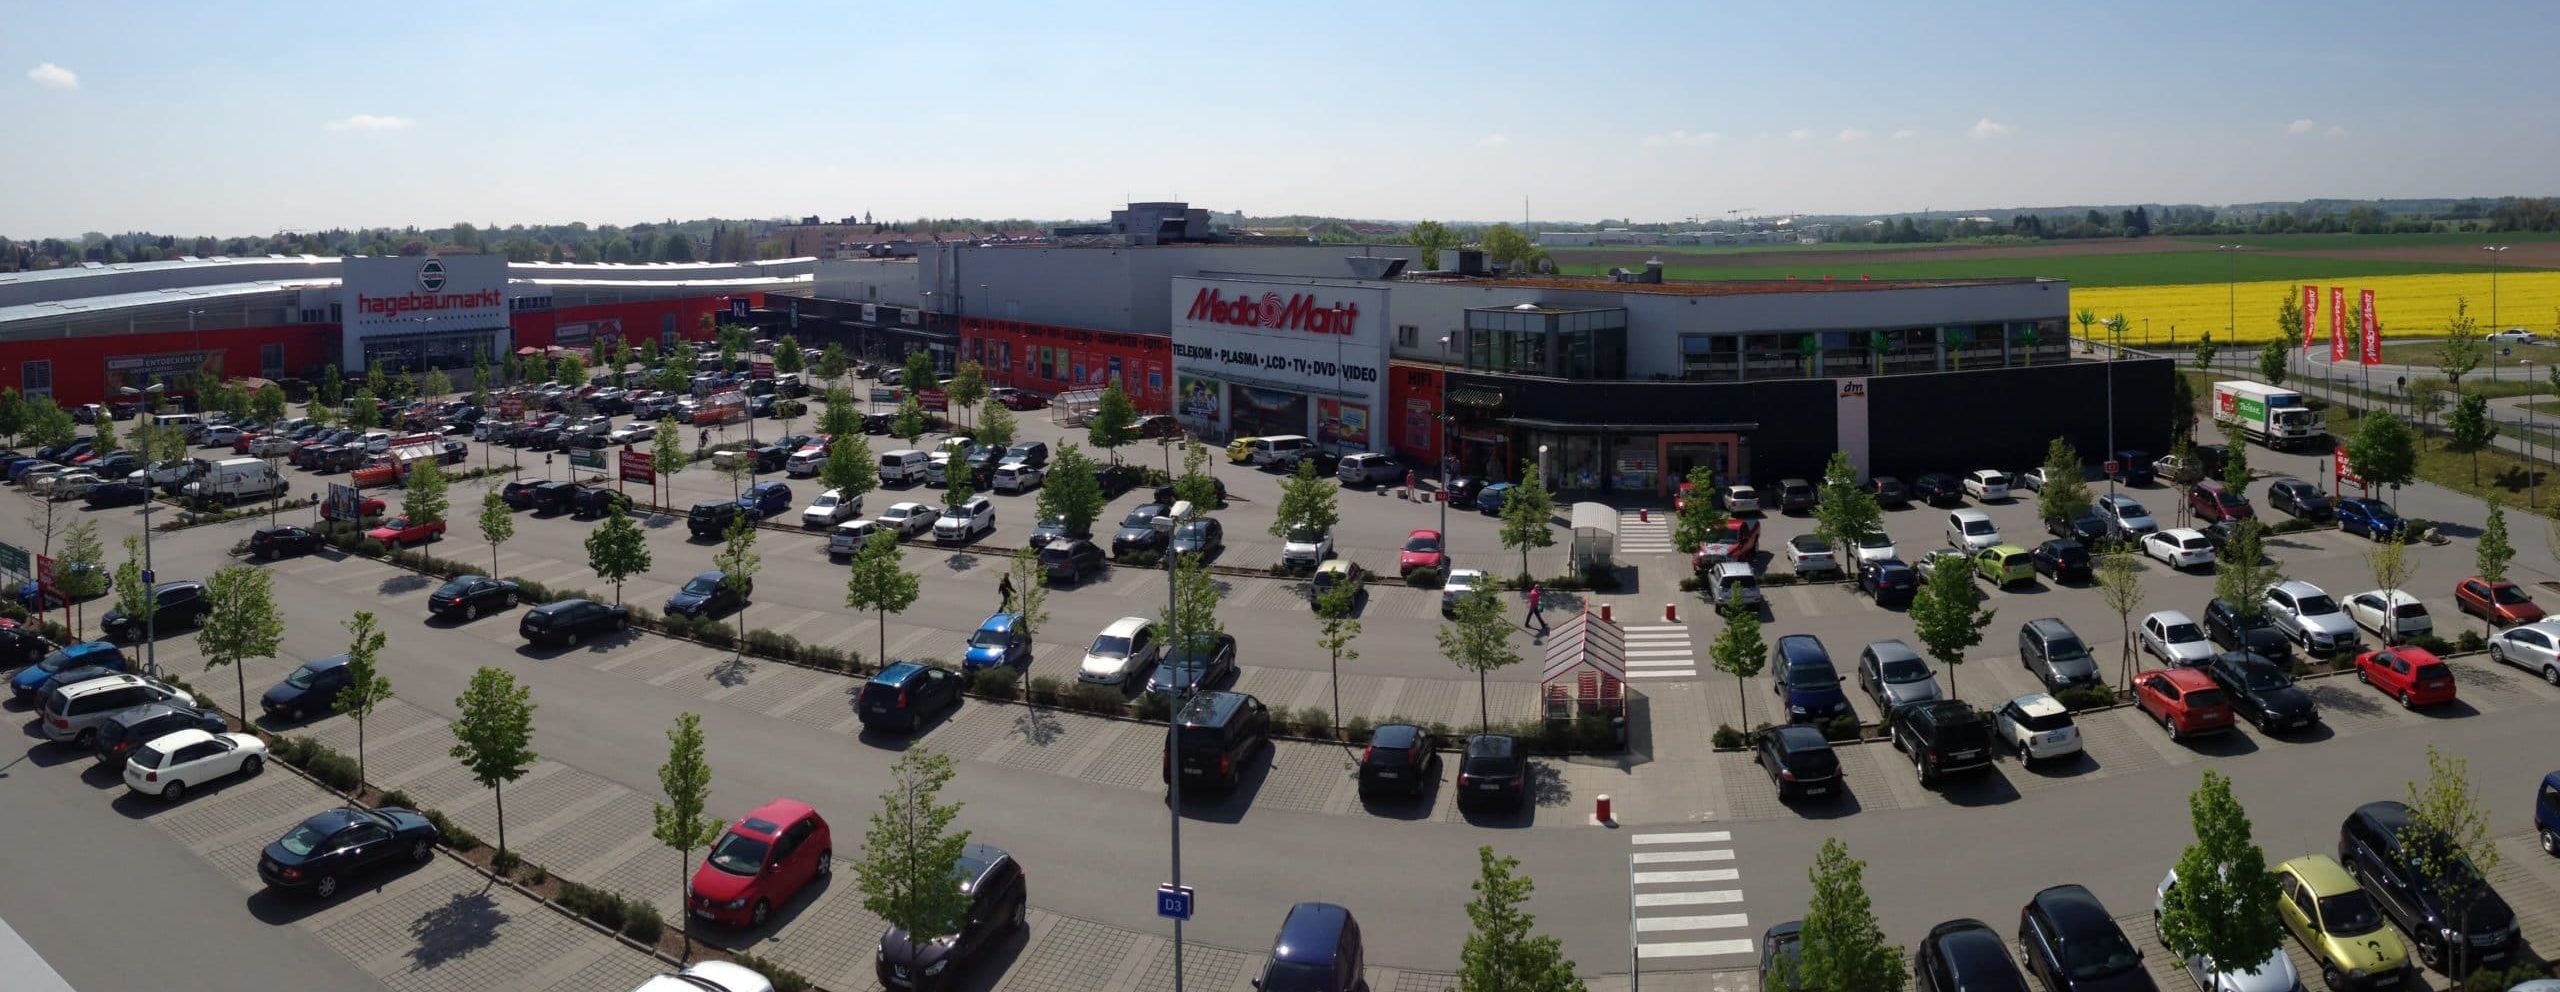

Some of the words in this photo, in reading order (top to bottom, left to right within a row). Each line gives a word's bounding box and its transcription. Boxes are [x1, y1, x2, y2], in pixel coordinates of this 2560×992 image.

[359, 288, 500, 317] hagebaumarkt
[1172, 343, 1212, 360] TELEKOM
[1220, 350, 1258, 367] PLASMA
[1266, 355, 1286, 370] LCD
[1293, 358, 1306, 373] TV
[1313, 363, 1336, 377] DVD
[1342, 365, 1377, 382] VIDEO
[1408, 371, 1432, 388] HIFI
[1844, 381, 1863, 393] dm
[1165, 898, 1182, 912] D3
